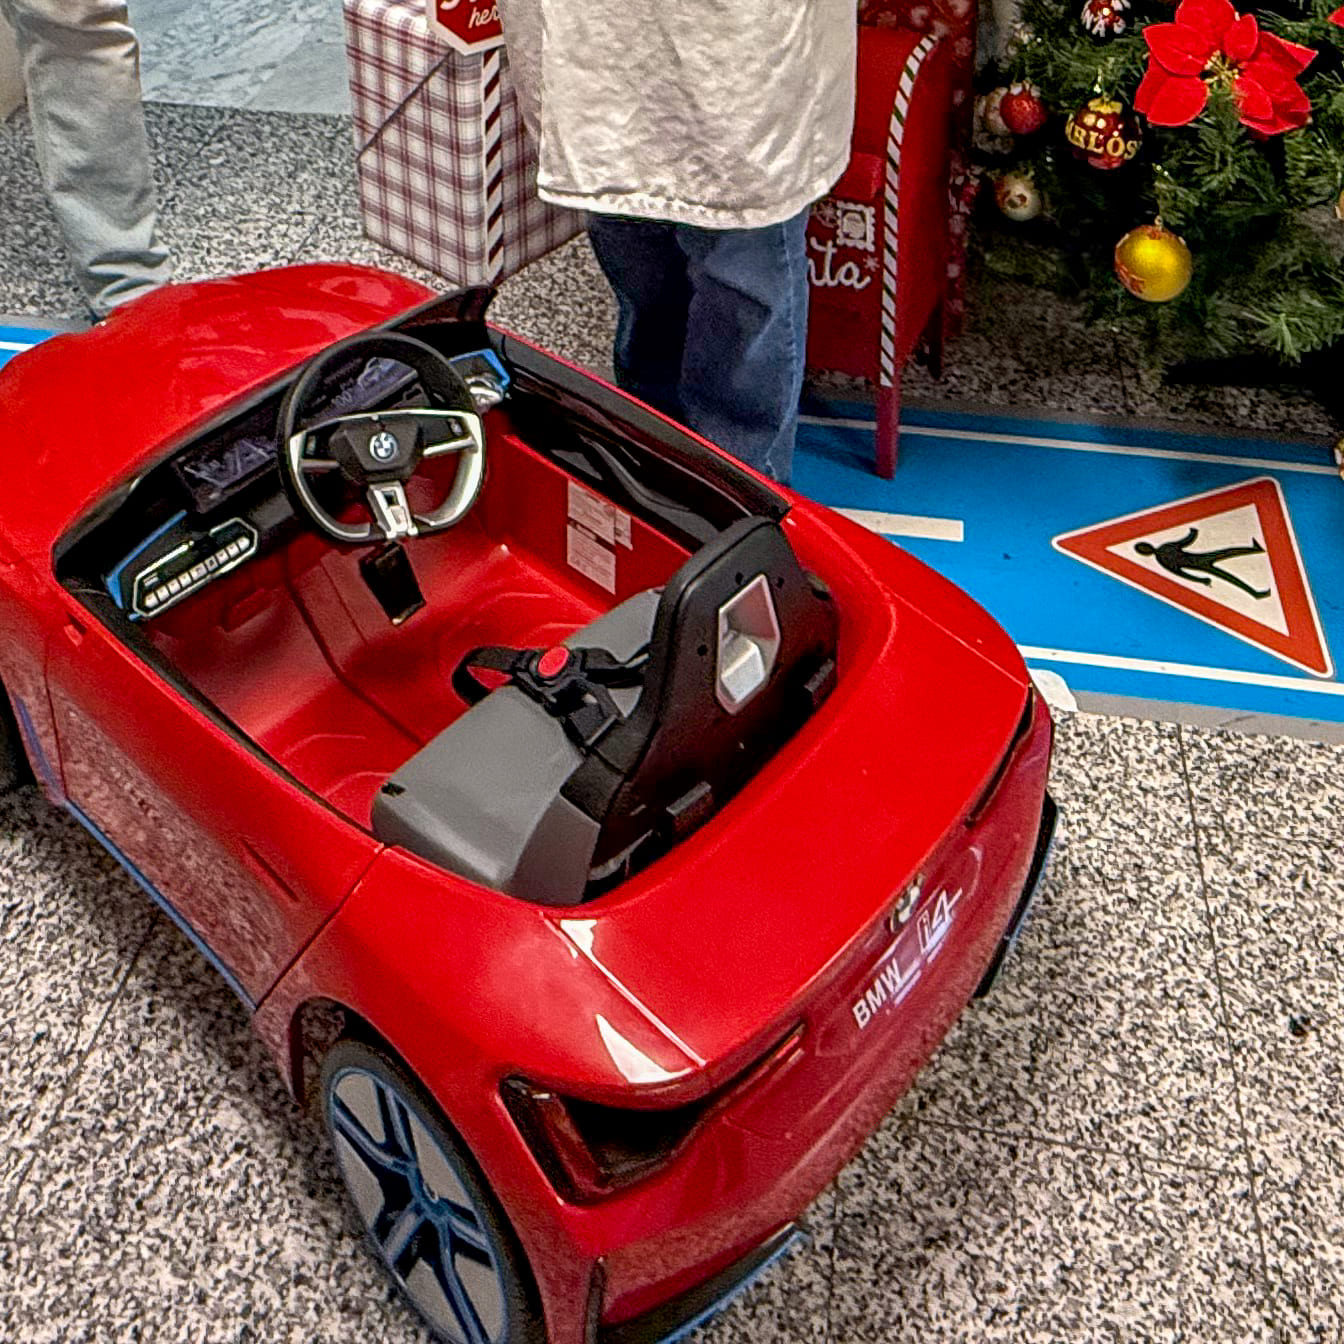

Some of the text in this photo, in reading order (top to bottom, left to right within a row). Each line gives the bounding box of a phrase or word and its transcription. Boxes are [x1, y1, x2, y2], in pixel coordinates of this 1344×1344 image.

[468, 6, 500, 29] her
[852, 886, 963, 1030] BMW i4
